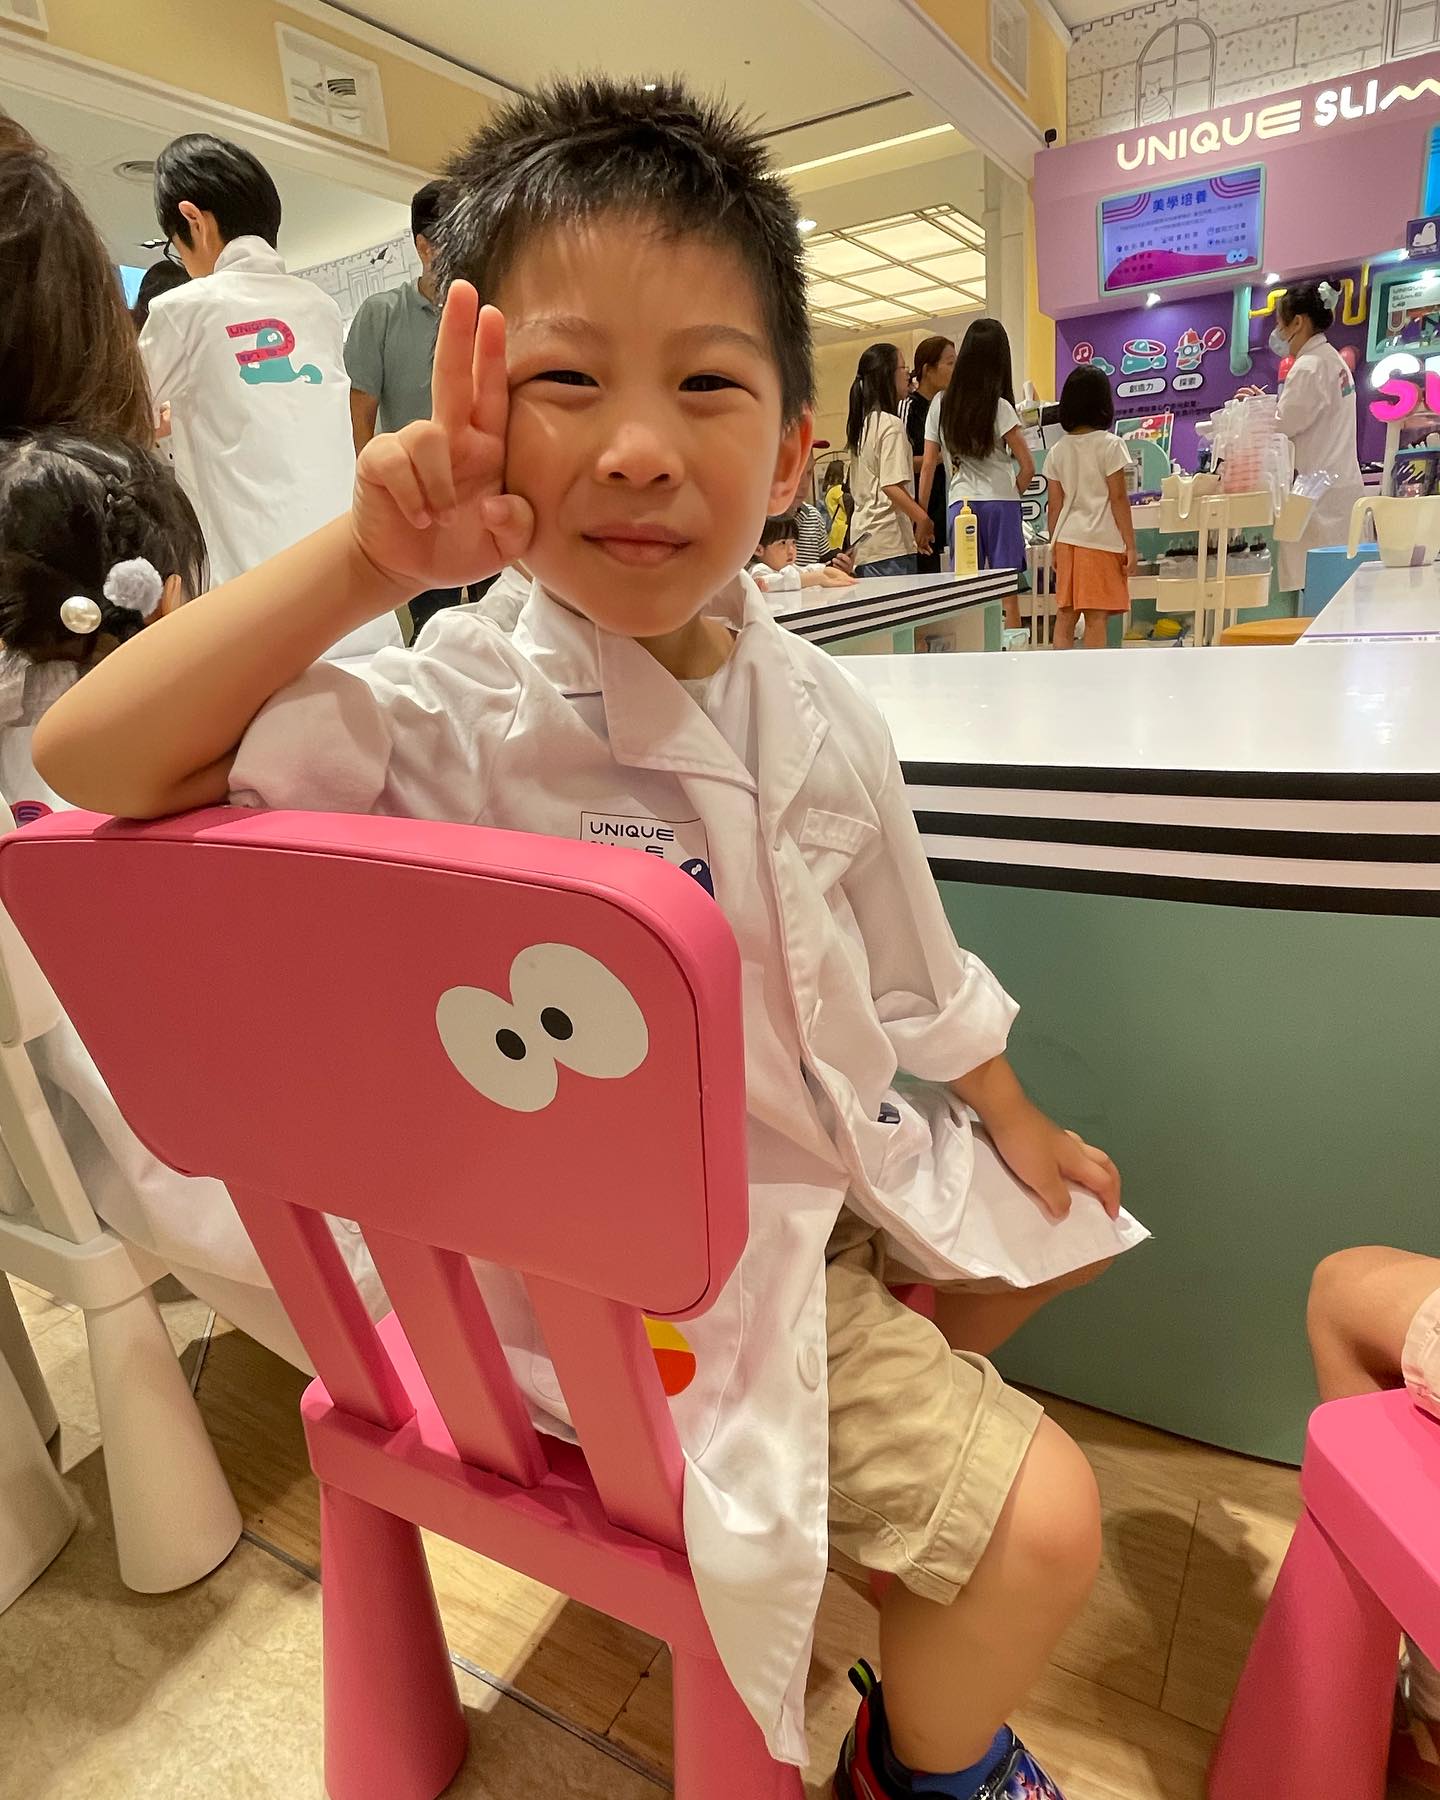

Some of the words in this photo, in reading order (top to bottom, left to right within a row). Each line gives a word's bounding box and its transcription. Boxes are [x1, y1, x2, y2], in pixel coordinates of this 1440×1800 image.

[1116, 99, 1302, 170] UNIQUE
[1152, 190, 1208, 213] 美學培養
[1129, 383, 1154, 393] 創造力
[590, 821, 674, 842] UNIQUE
